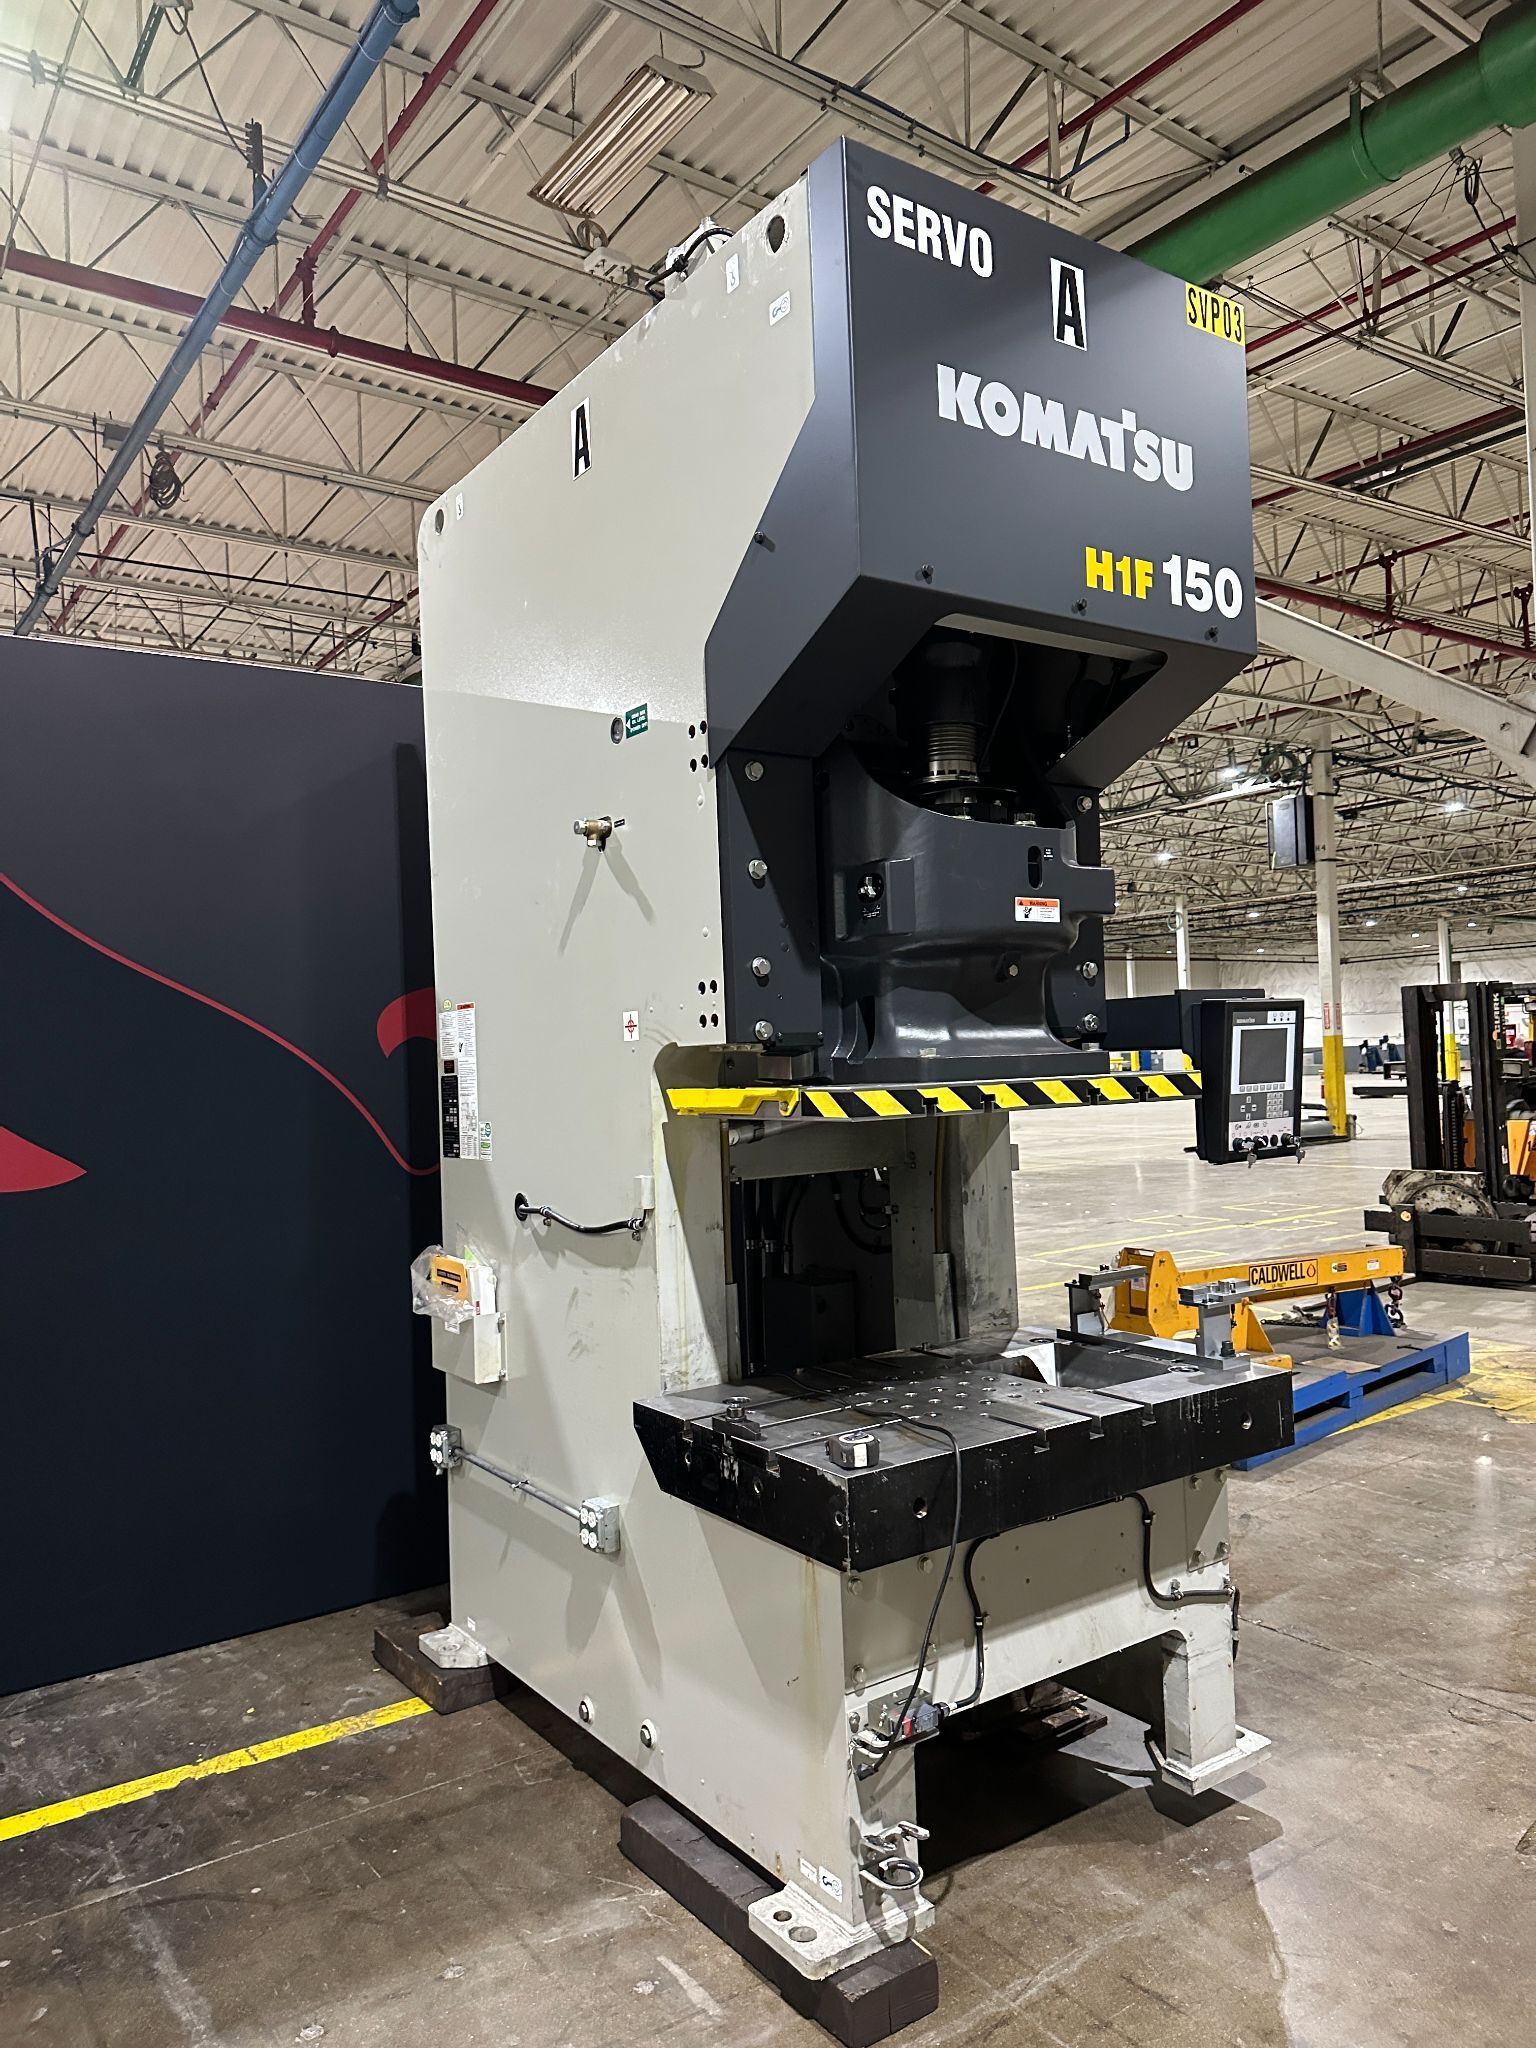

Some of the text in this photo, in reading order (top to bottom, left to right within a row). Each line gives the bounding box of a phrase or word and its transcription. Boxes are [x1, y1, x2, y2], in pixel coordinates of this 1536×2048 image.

[867, 185, 993, 278] SERVO
[1057, 266, 1084, 348] A
[1187, 286, 1243, 344] SVP03
[575, 404, 590, 477] A
[937, 363, 1194, 492] KOMATSU
[1085, 546, 1243, 619] H1F 150
[1492, 992, 1501, 1033] CLARK
[1251, 1263, 1305, 1285] CALDWELL
